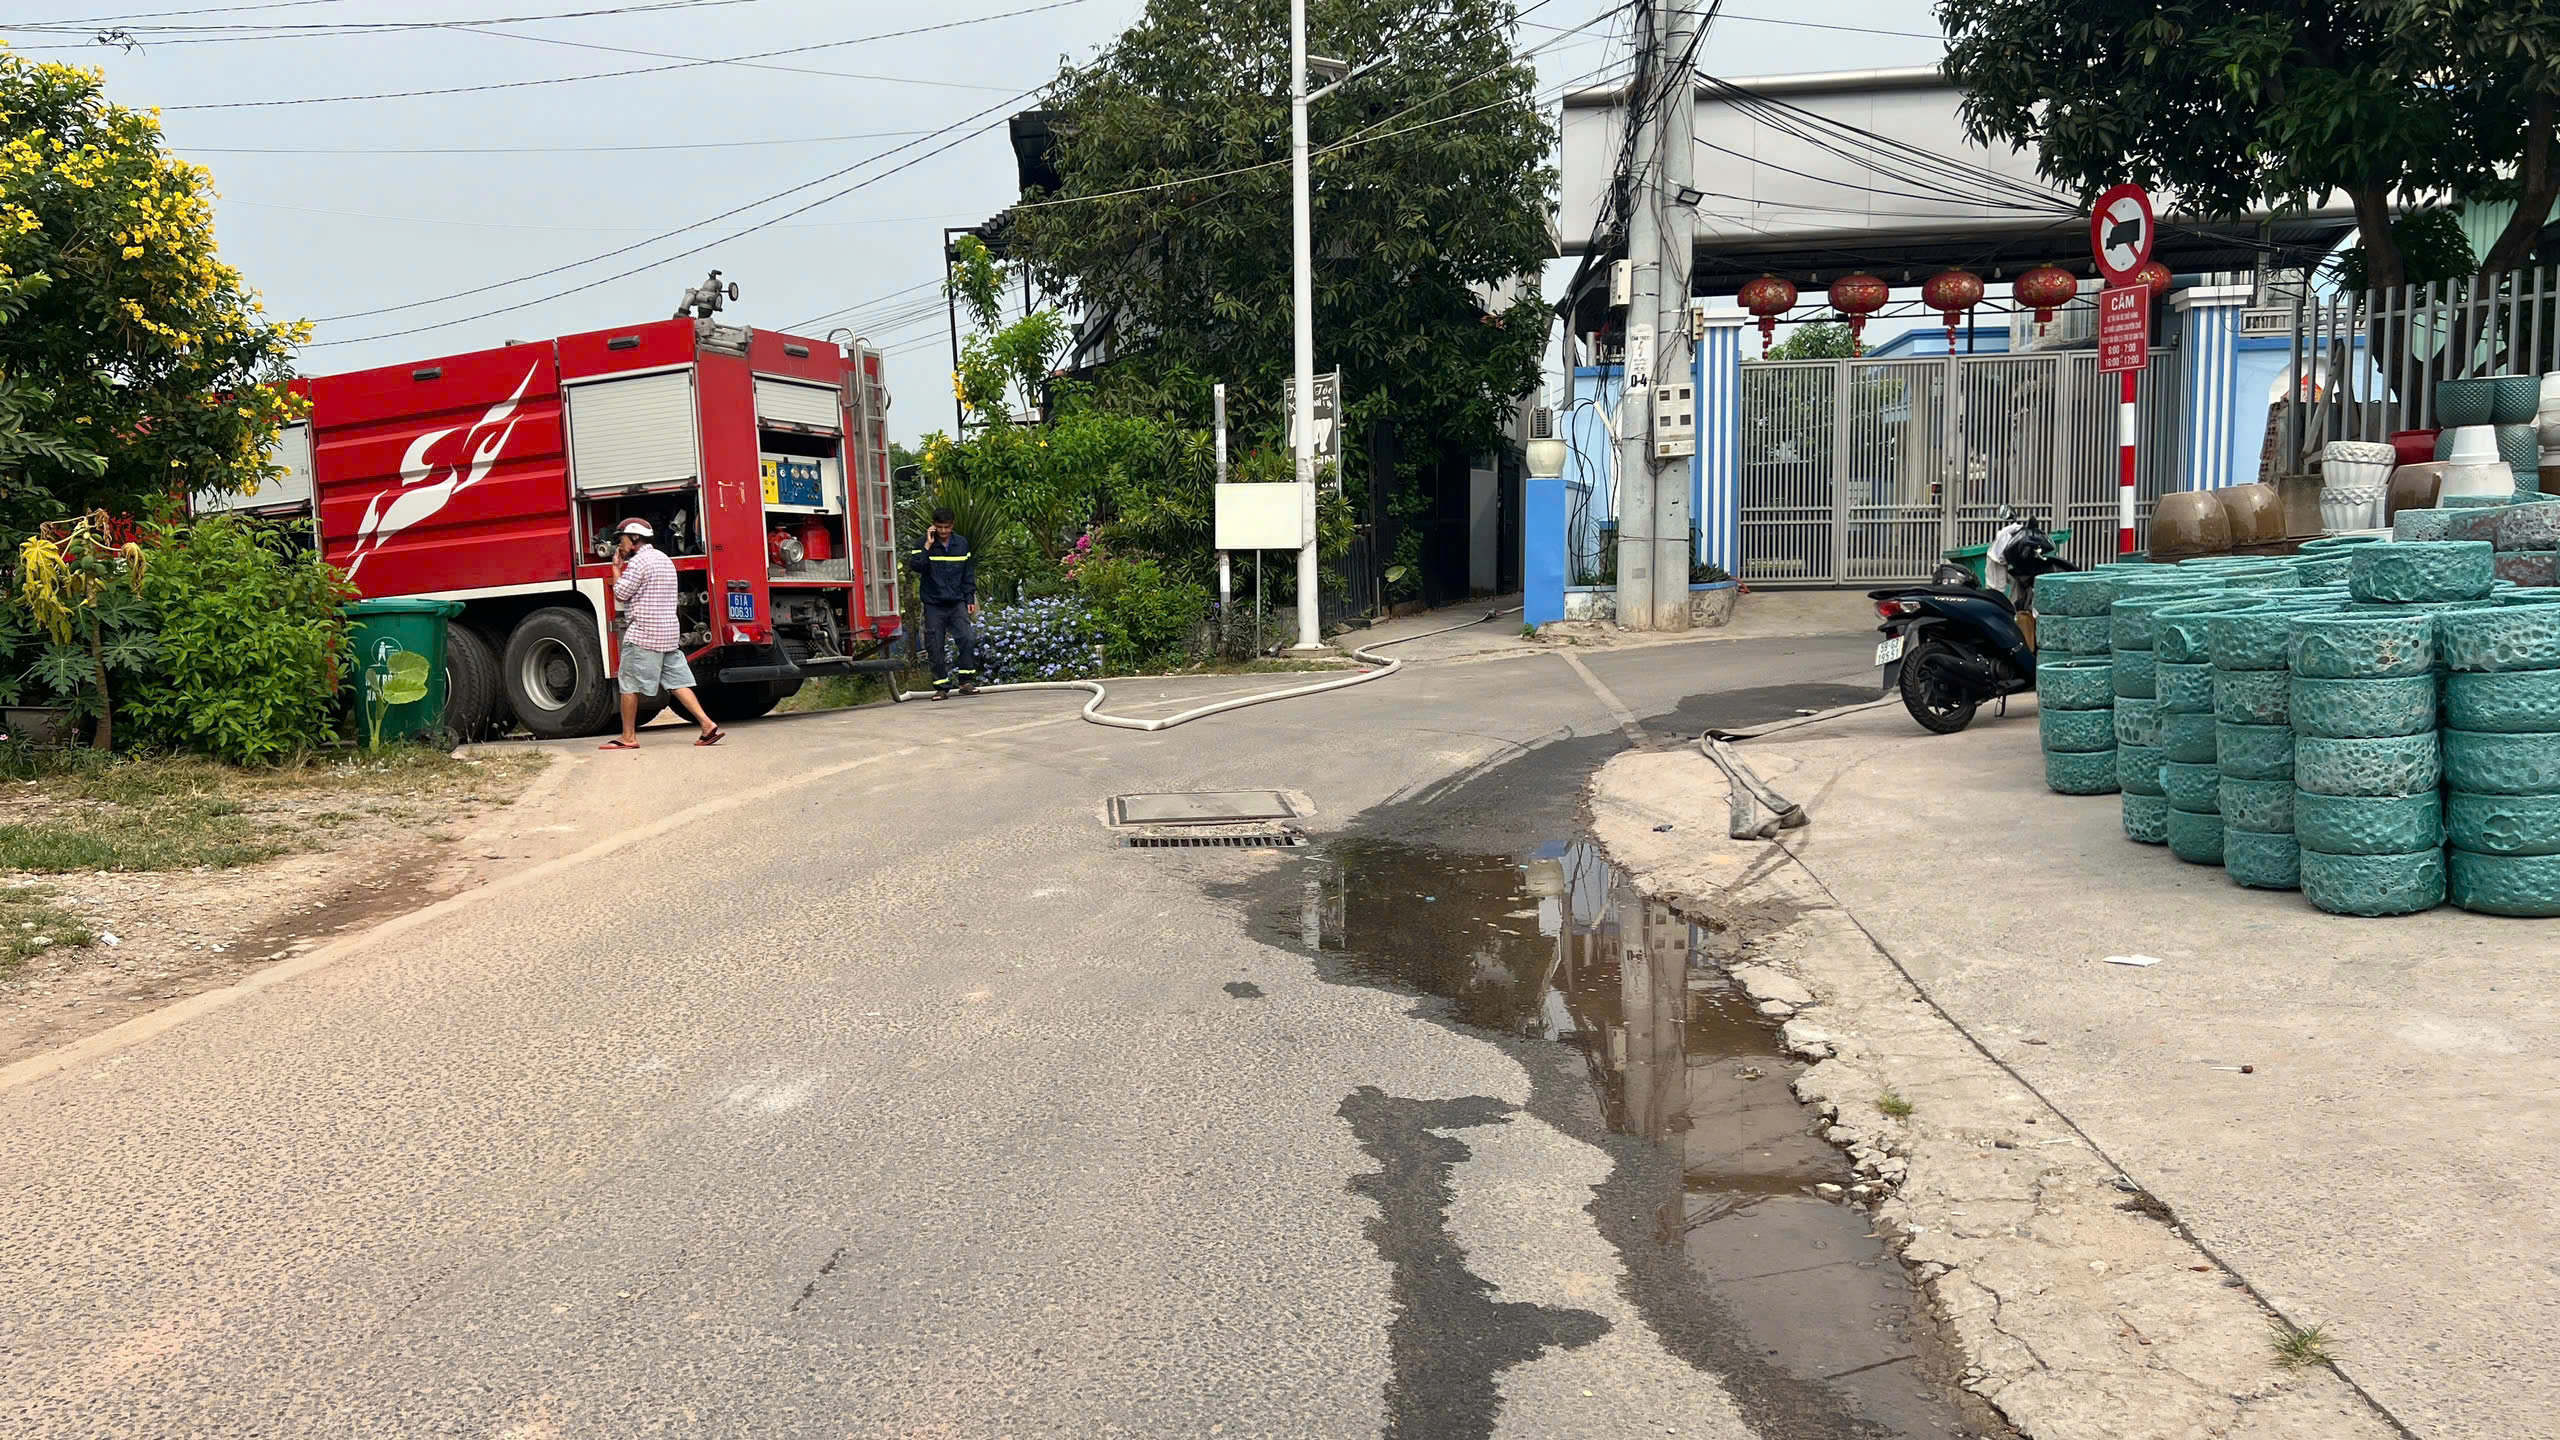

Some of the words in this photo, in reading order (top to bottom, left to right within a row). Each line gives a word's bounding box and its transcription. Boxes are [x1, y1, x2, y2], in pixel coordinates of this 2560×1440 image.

[2111, 292, 2135, 311] CẤM
[2107, 345, 2120, 355] 6:00
[2124, 343, 2136, 353] 7:00
[2124, 355, 2139, 366] 17:00
[734, 594, 748, 606] 61A
